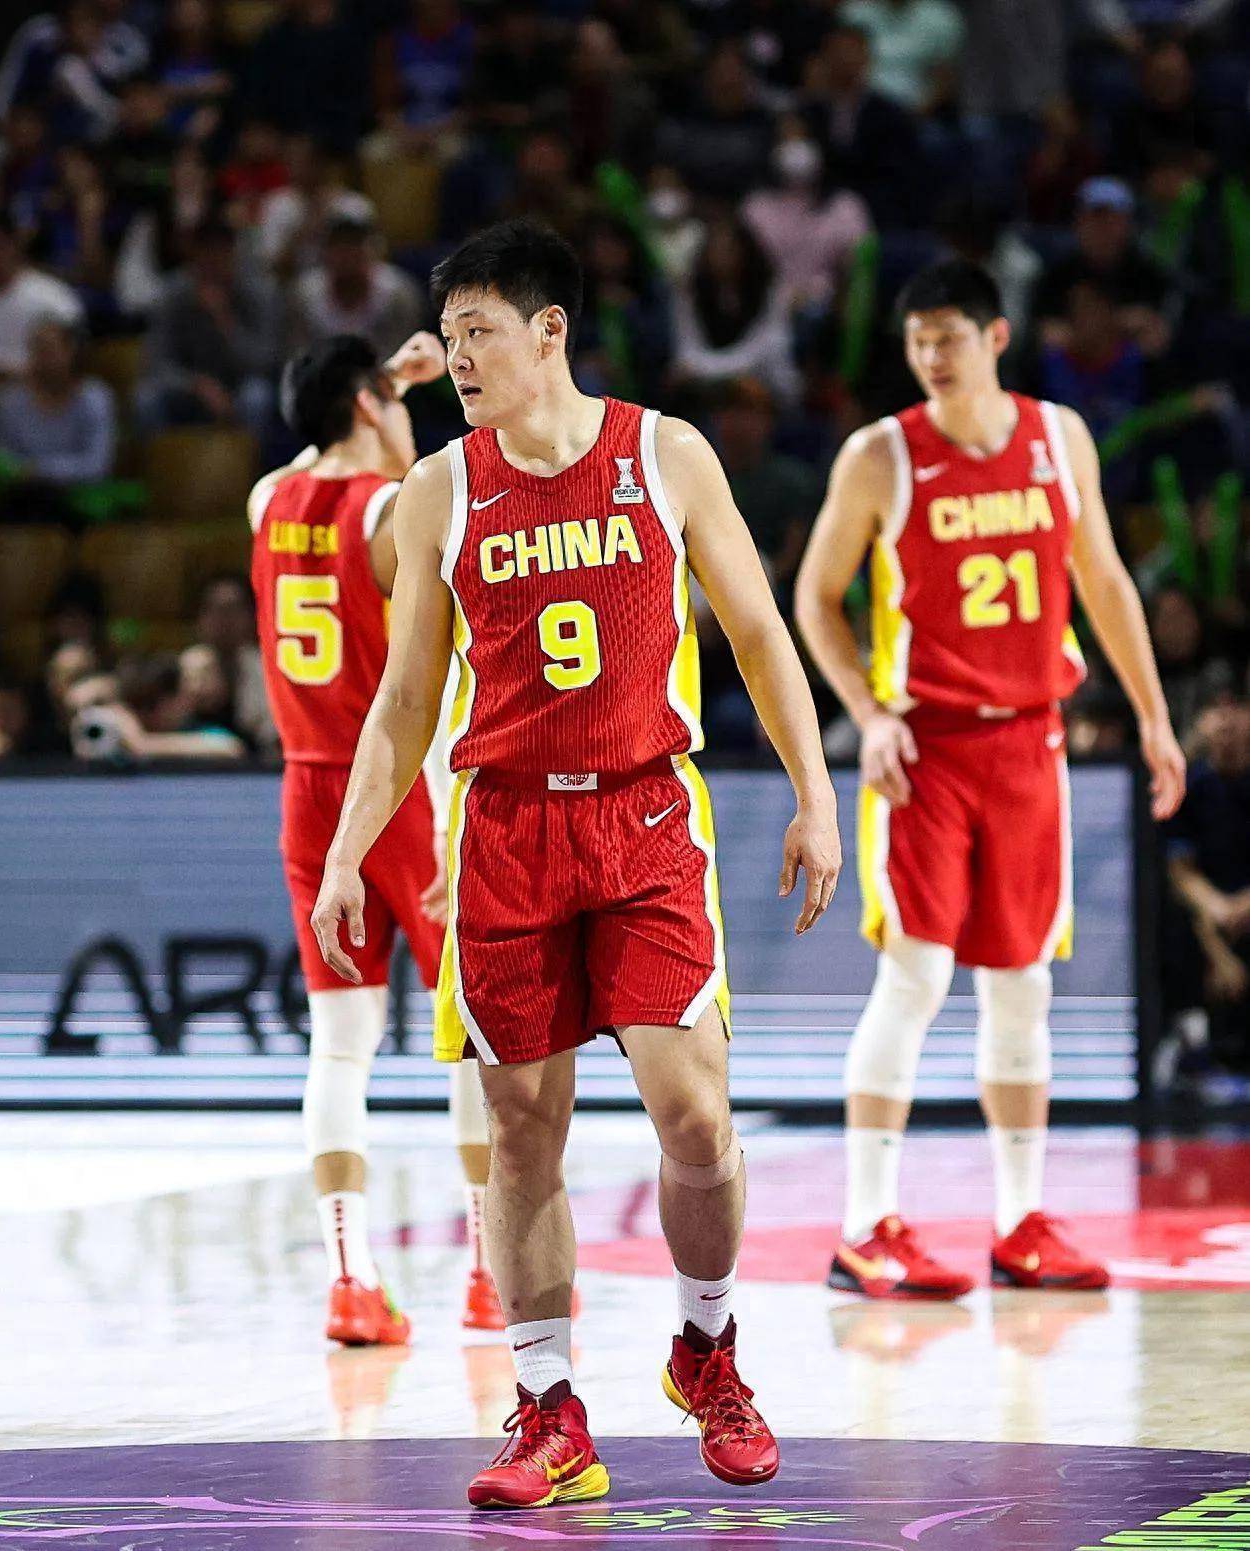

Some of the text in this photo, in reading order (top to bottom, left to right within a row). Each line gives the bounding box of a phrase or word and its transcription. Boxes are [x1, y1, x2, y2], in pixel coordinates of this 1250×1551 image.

[479, 514, 644, 584] CHINA
[928, 486, 1055, 543] CHINA
[957, 550, 1041, 628] 21
[277, 574, 343, 686] 5
[538, 600, 602, 691] 9
